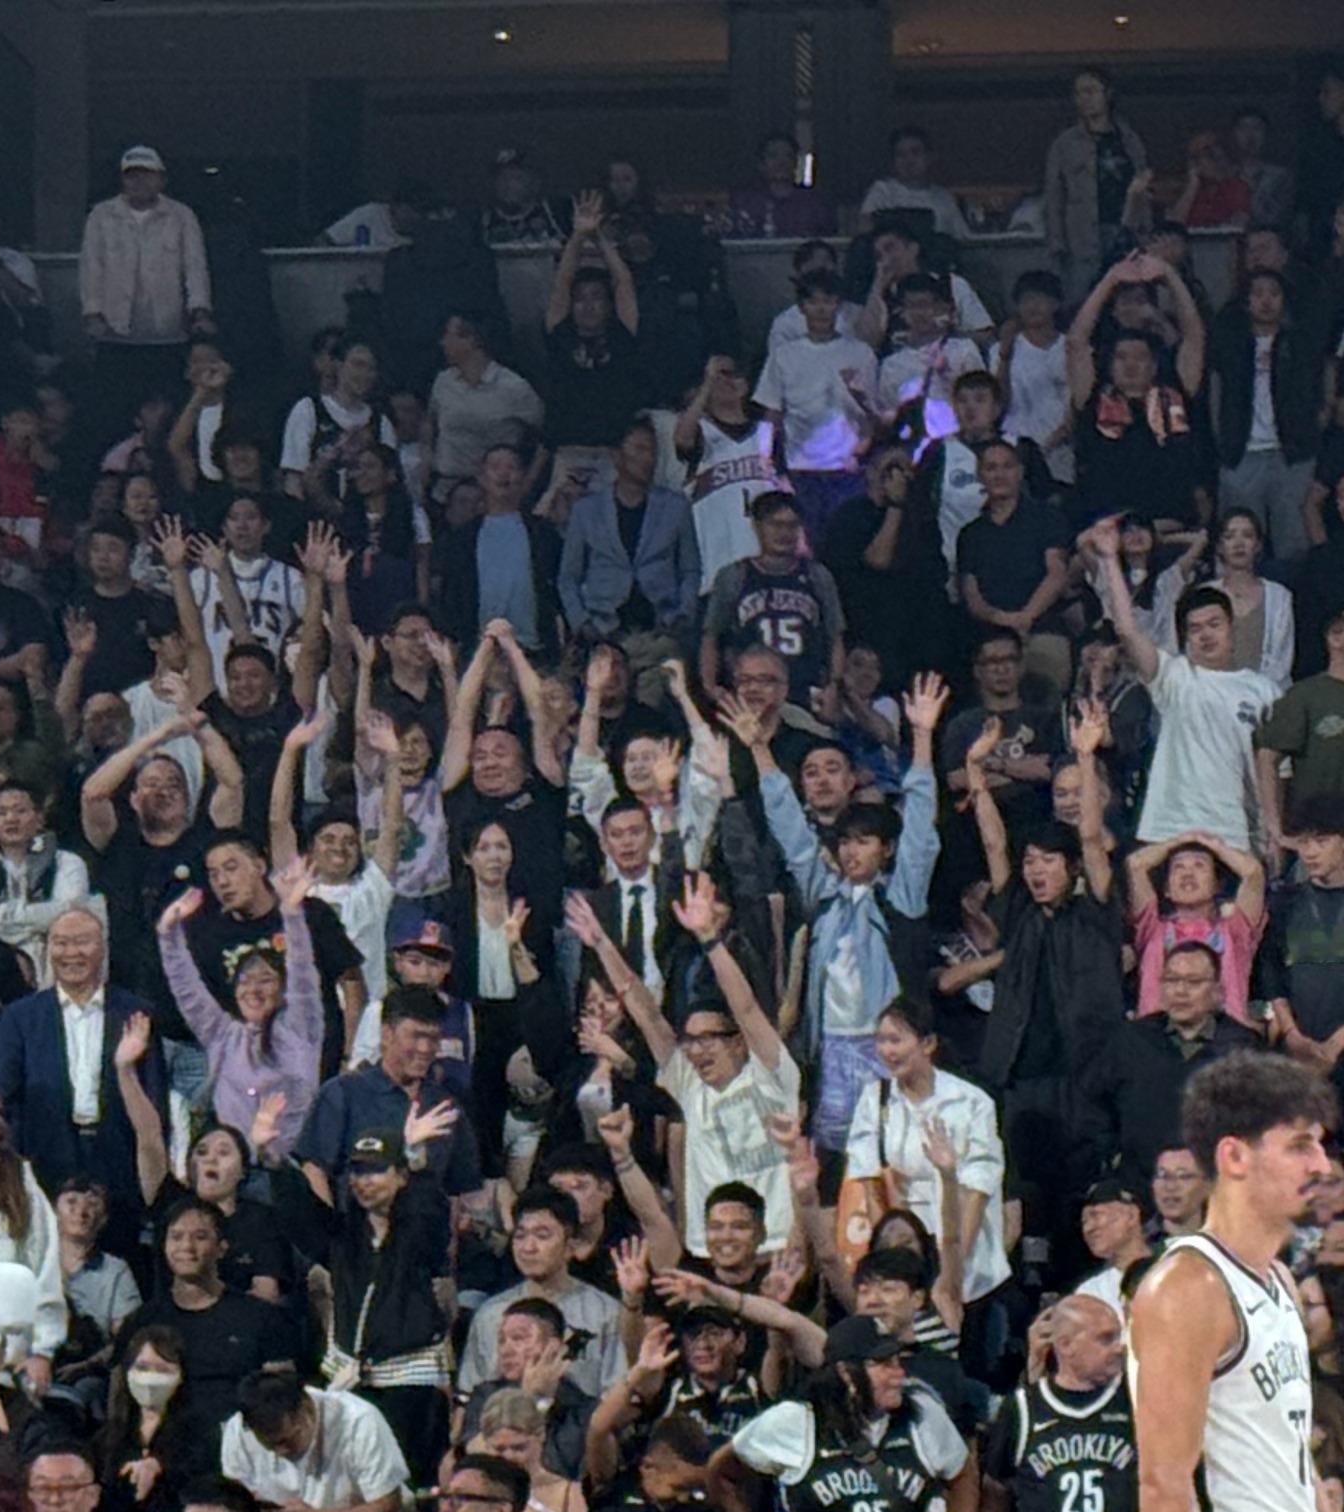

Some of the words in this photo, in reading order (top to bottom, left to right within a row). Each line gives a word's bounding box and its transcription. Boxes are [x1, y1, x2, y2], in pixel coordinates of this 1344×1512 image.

[759, 615, 805, 656] 15
[1026, 1432, 1134, 1478] BROOKLYN
[811, 1465, 926, 1507] BROOYN
